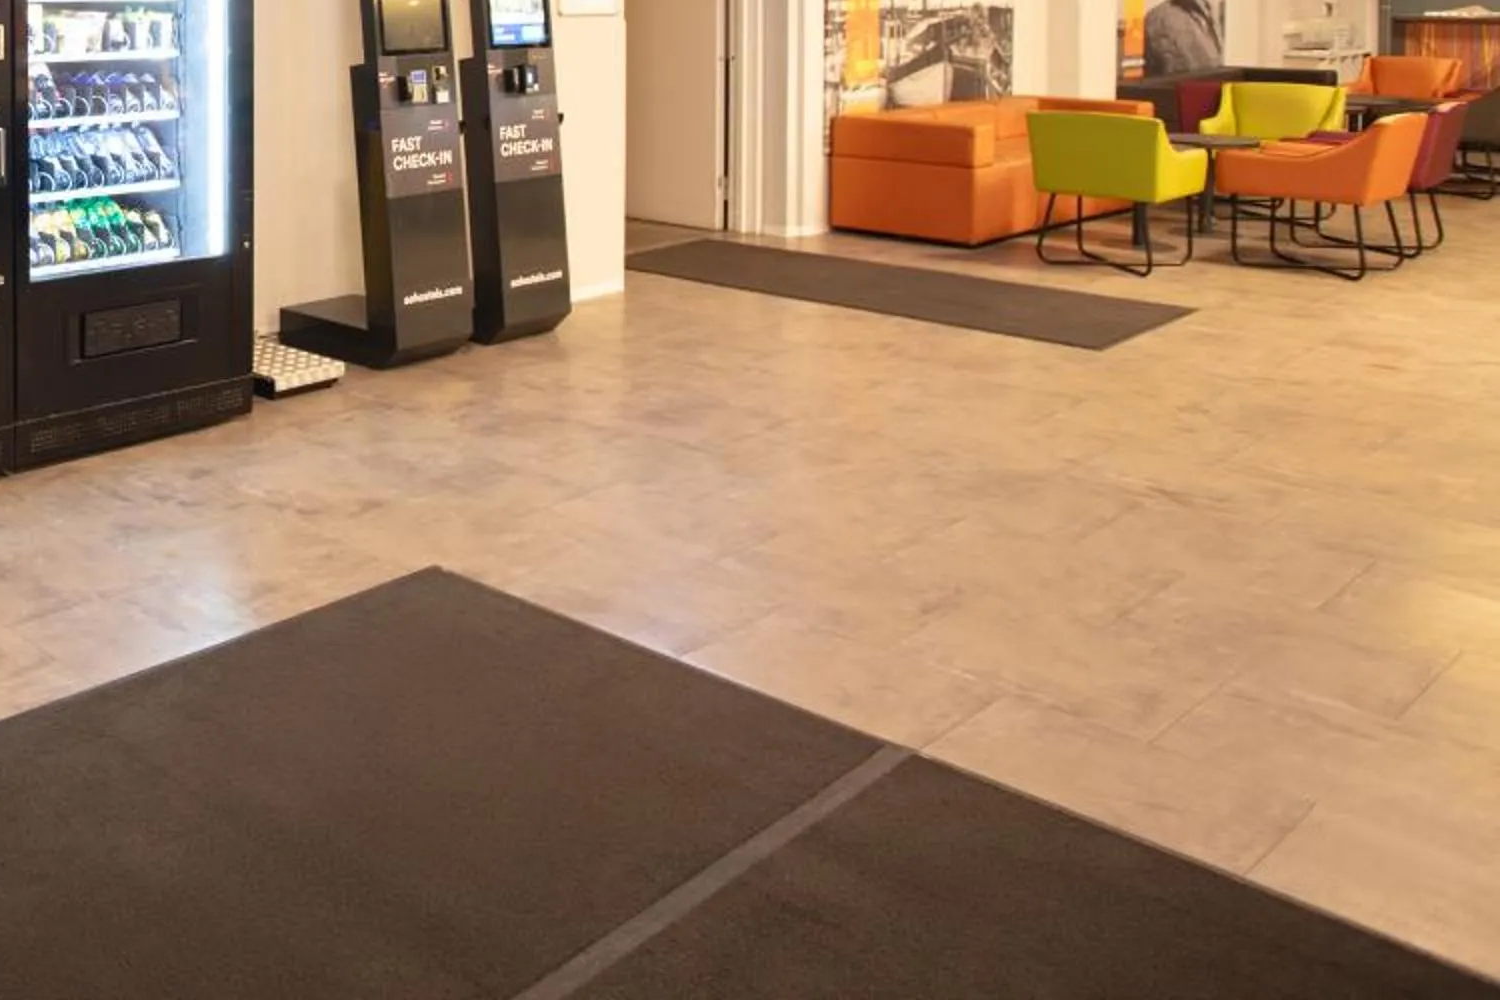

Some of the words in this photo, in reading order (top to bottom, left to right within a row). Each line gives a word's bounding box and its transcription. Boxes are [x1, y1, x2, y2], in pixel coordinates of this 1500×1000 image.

[500, 124, 527, 140] FAST
[391, 135, 422, 152] FAST
[501, 138, 553, 157] CHECK-IN
[393, 150, 452, 171] CHECK-IN
